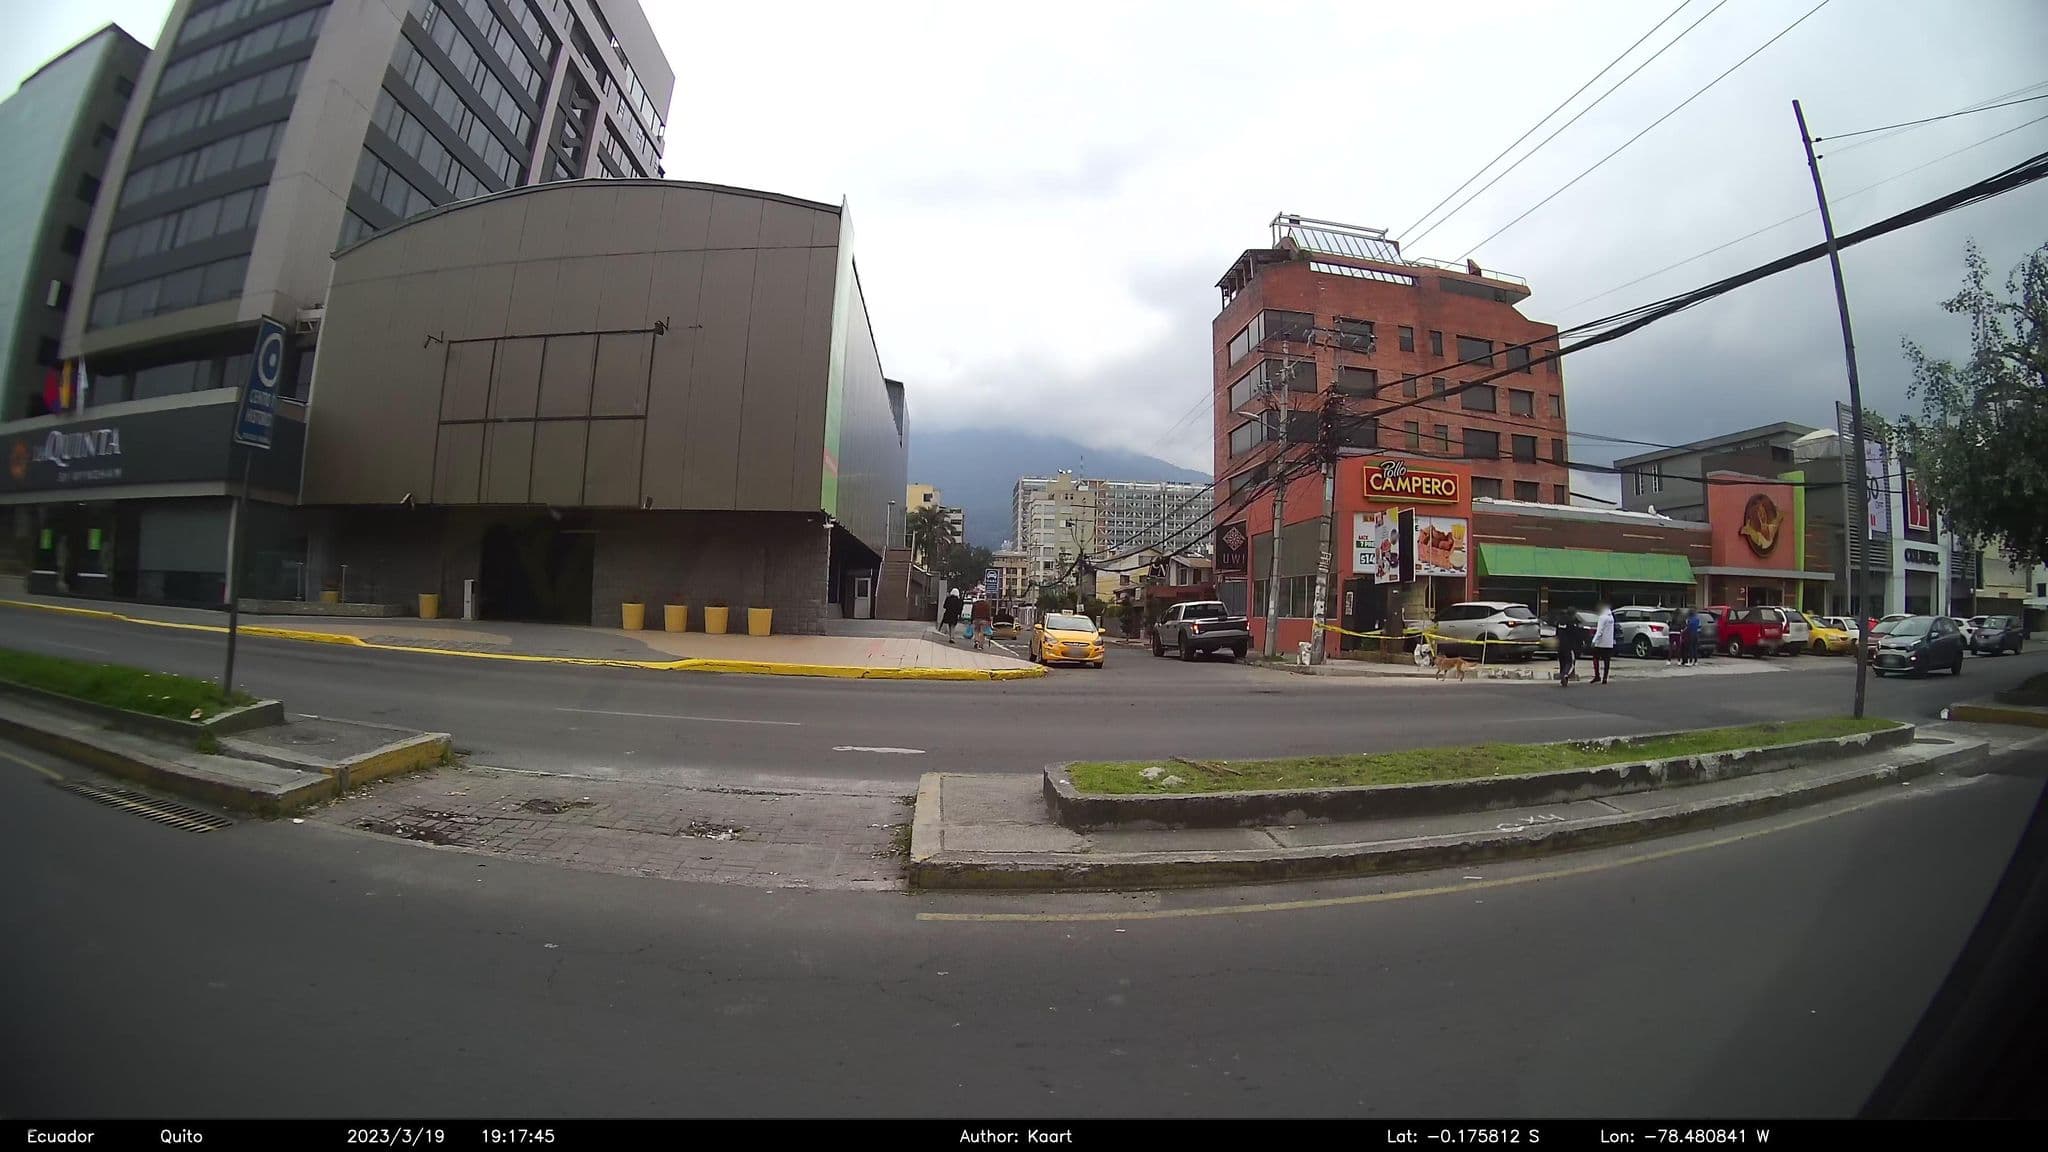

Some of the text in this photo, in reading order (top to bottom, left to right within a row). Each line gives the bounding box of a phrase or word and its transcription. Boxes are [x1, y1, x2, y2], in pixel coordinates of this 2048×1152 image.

[46, 428, 121, 467] QUINTA
[1380, 460, 1407, 478] Pollo
[1369, 472, 1456, 496] CAMPERO
